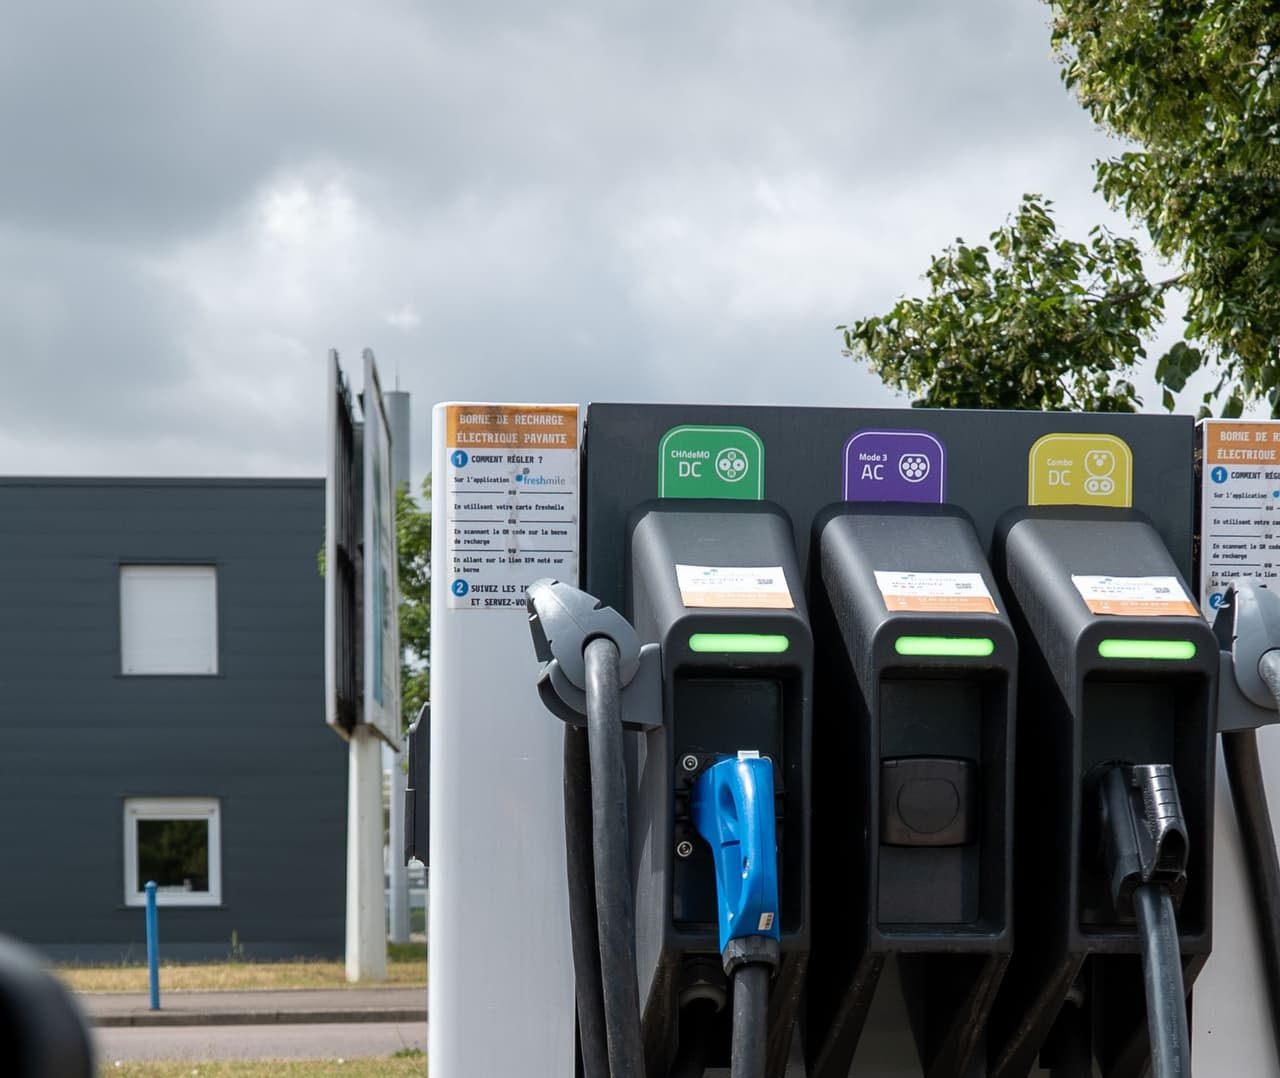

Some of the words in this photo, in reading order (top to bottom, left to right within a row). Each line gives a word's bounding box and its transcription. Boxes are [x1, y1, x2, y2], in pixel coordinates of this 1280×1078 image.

[460, 414, 490, 425] BORNE
[496, 414, 509, 425] DE
[515, 415, 564, 425] RECHARGE
[457, 431, 518, 443] ÉLECTRIQUE
[524, 433, 567, 444] PAYANTE
[1220, 431, 1249, 442] BORNE
[1256, 432, 1268, 442] DE
[671, 450, 710, 459] CHAdeMO
[859, 453, 881, 461] Mode
[1217, 448, 1276, 459] ÉLECTRIQUE
[471, 455, 503, 463] COMMENT
[507, 454, 534, 464] RÉGLER
[1047, 458, 1073, 466] Combo
[679, 461, 702, 477] DC
[861, 464, 884, 480] AC
[523, 475, 566, 485] freshmile
[1048, 470, 1071, 486] DC
[455, 583, 464, 593] 2
[471, 584, 498, 593] SUIVEZ
[502, 584, 516, 593] LES
[471, 598, 480, 606] ET
[484, 598, 527, 606] SERVEZ-VO
